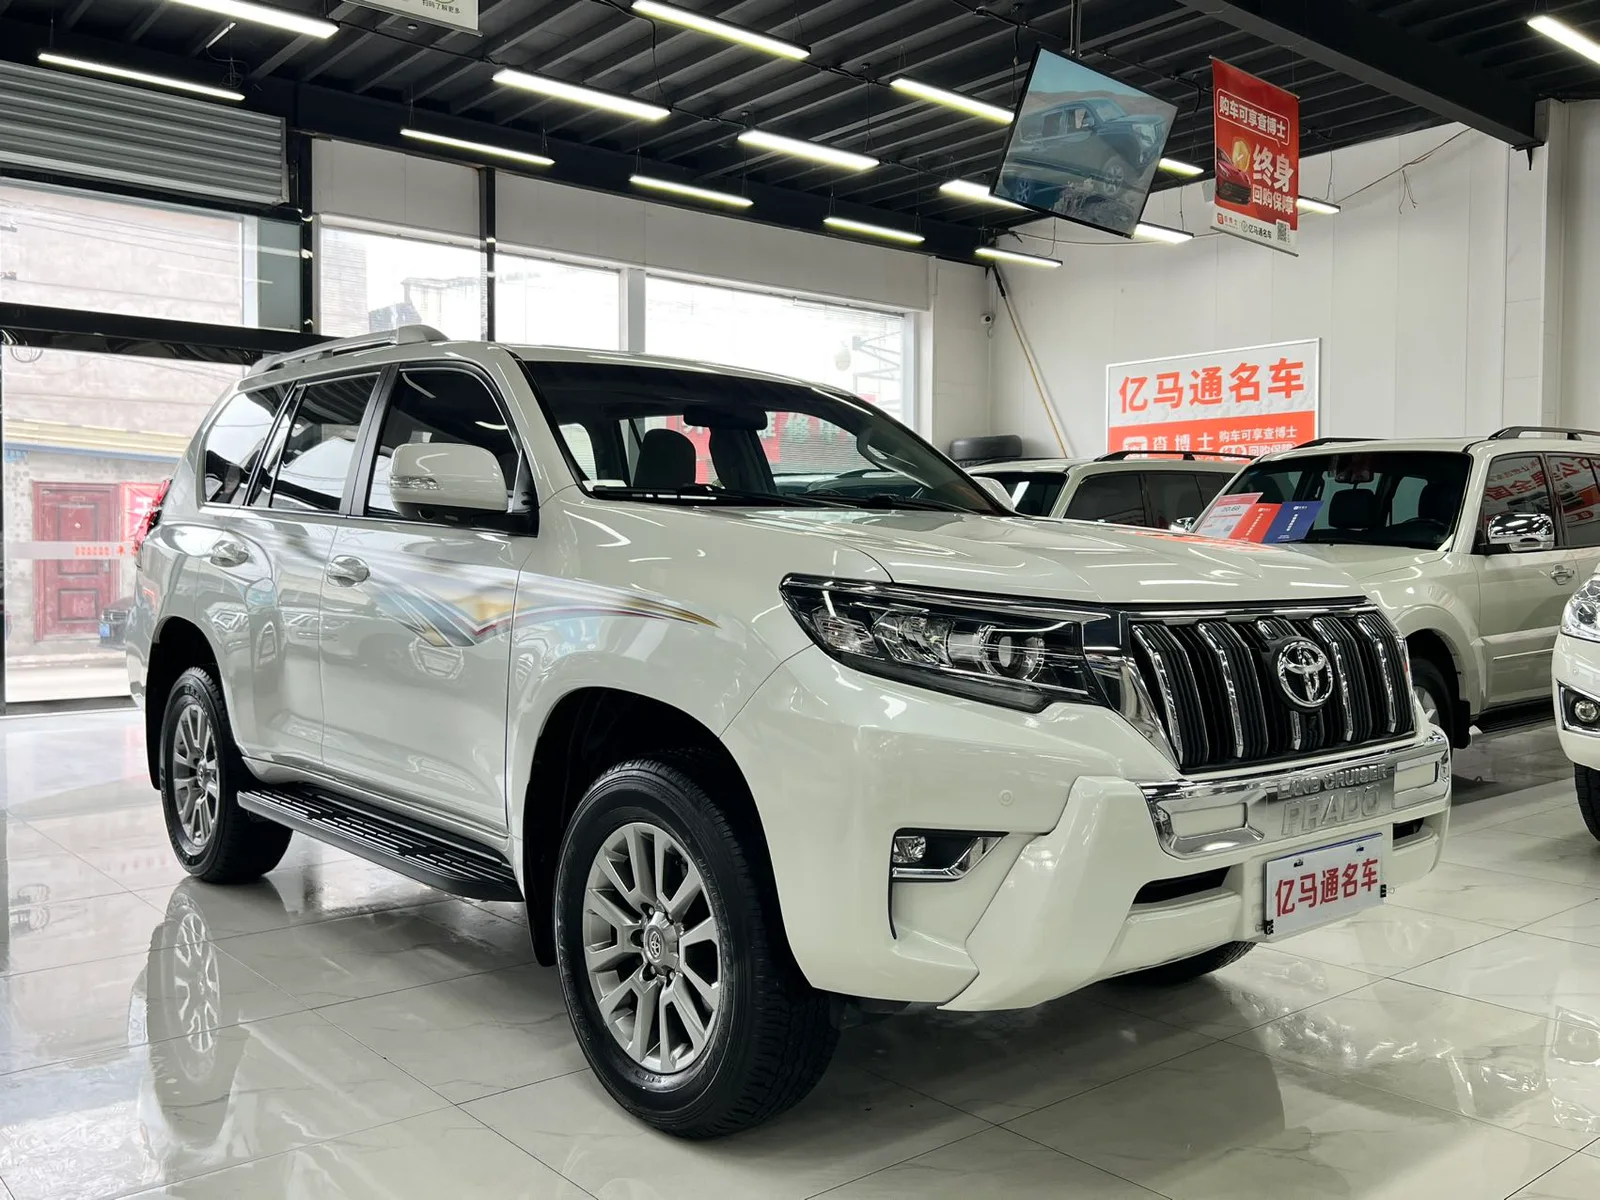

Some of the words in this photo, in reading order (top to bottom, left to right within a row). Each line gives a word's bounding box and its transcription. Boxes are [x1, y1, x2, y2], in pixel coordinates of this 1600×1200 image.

[1219, 96, 1286, 139] 购车可享查博士
[1252, 143, 1294, 193] 终身
[1252, 184, 1294, 216] 回购保障
[1118, 357, 1304, 414] 亿马通名车
[1219, 425, 1297, 443] 购车可享查博士
[1277, 775, 1321, 800] LAND
[1323, 764, 1387, 790] CRUISER
[1281, 784, 1382, 836] PRADO
[1275, 858, 1379, 917] 亿马通名车
